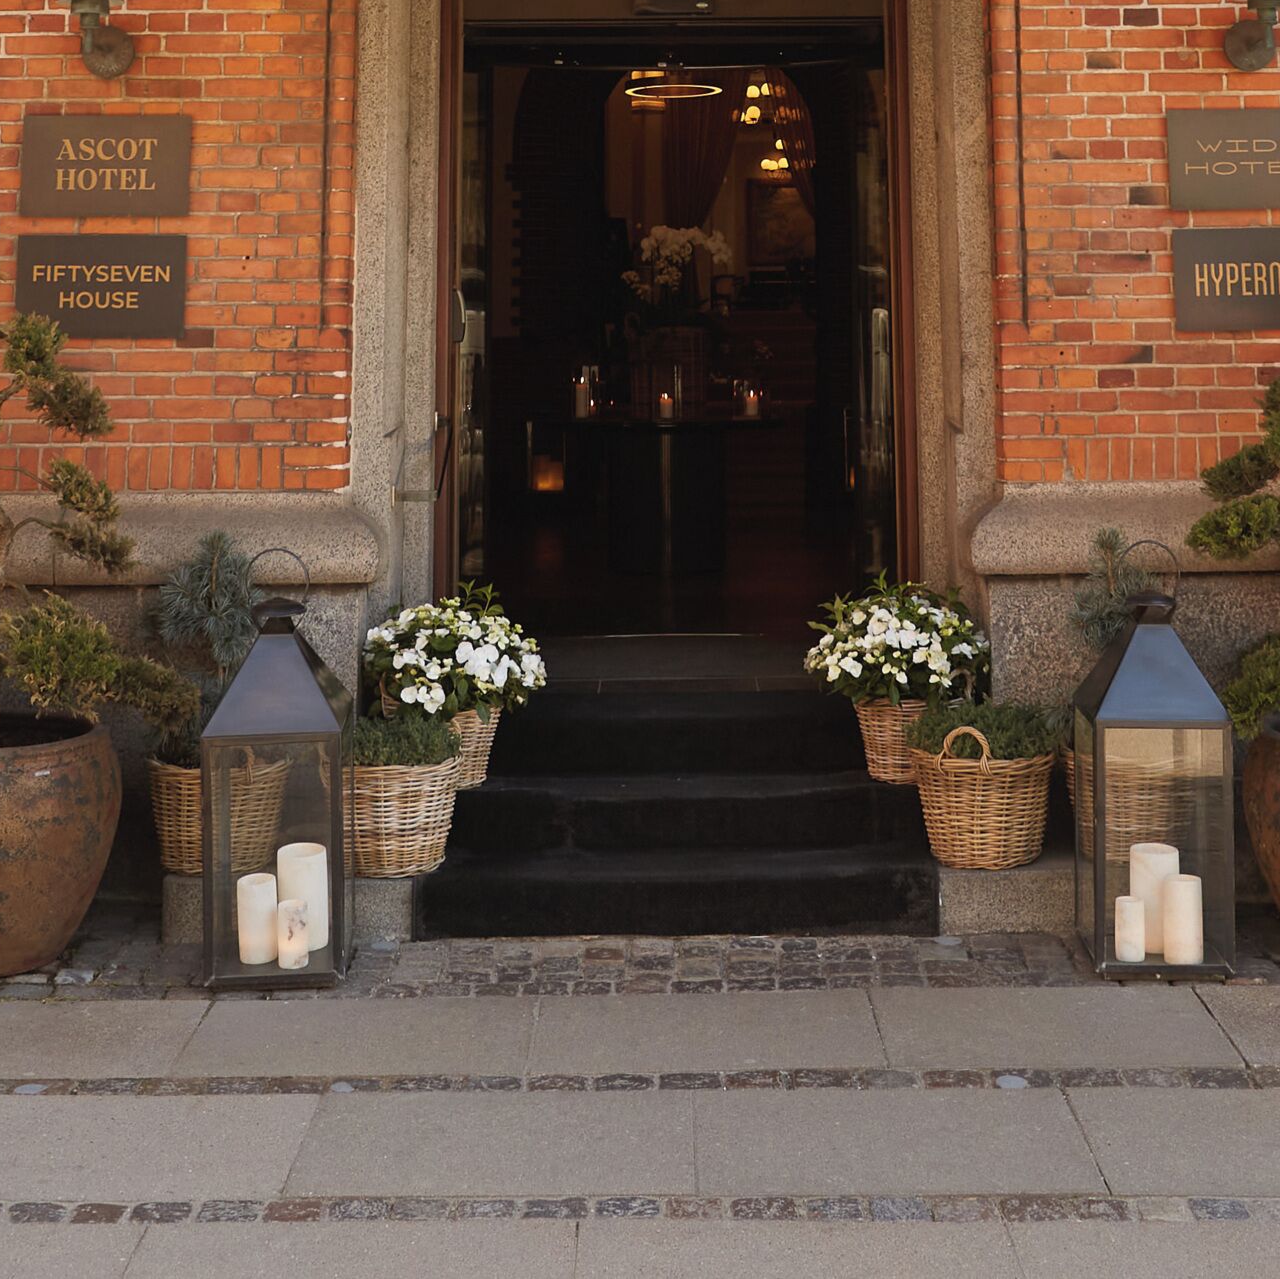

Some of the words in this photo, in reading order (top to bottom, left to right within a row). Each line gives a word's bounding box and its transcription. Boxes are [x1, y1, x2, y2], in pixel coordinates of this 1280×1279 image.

[55, 138, 158, 161] ASCOT
[55, 168, 157, 191] HOTEL
[31, 265, 171, 283] FIFTYSEVEN
[58, 291, 140, 309] HOUSE
